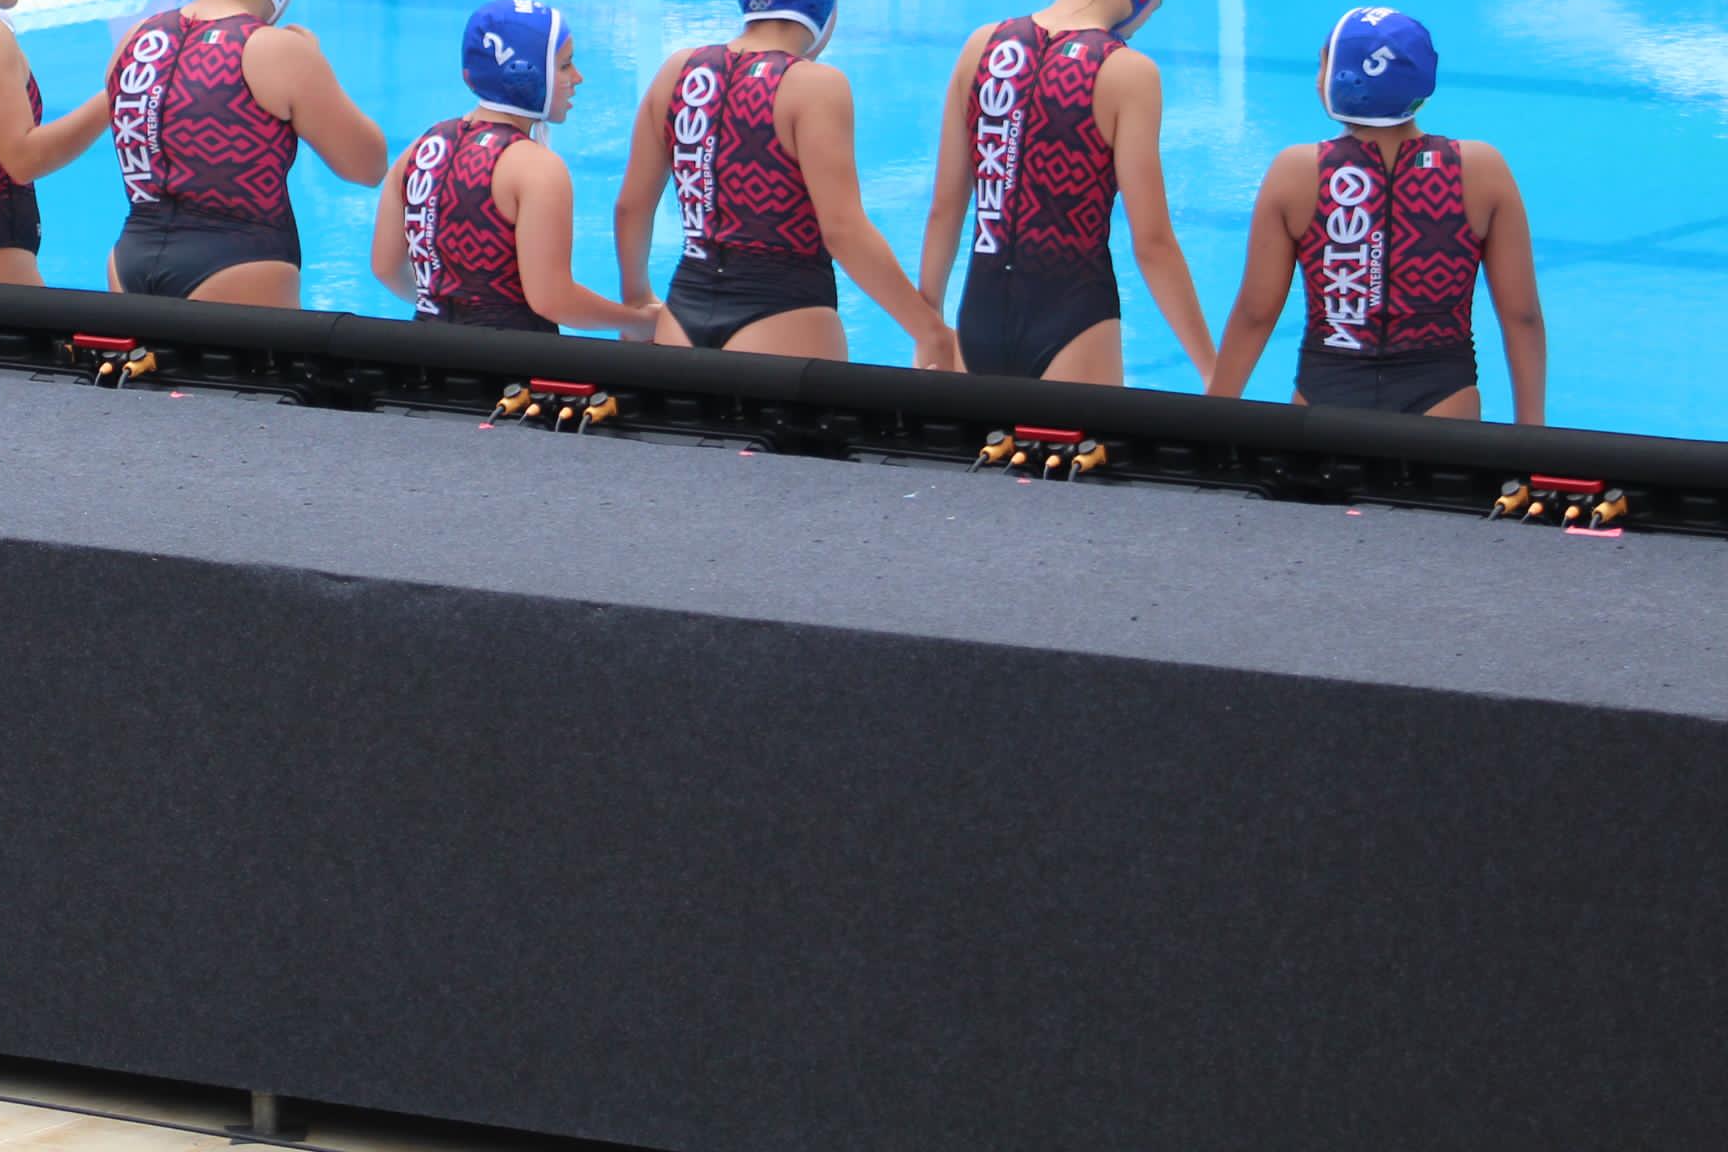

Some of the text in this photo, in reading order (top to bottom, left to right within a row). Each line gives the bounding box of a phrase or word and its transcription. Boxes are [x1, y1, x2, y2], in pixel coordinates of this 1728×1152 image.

[483, 31, 516, 66] 2
[1362, 45, 1396, 77] 5
[149, 84, 164, 155] WATERPOLO
[974, 39, 1027, 255] MEXICO
[1003, 108, 1023, 191] WATERPOLO
[702, 134, 716, 213] WATERPOLO
[426, 195, 441, 271] WATERPOLO
[1369, 229, 1384, 308] WATERPOLO
